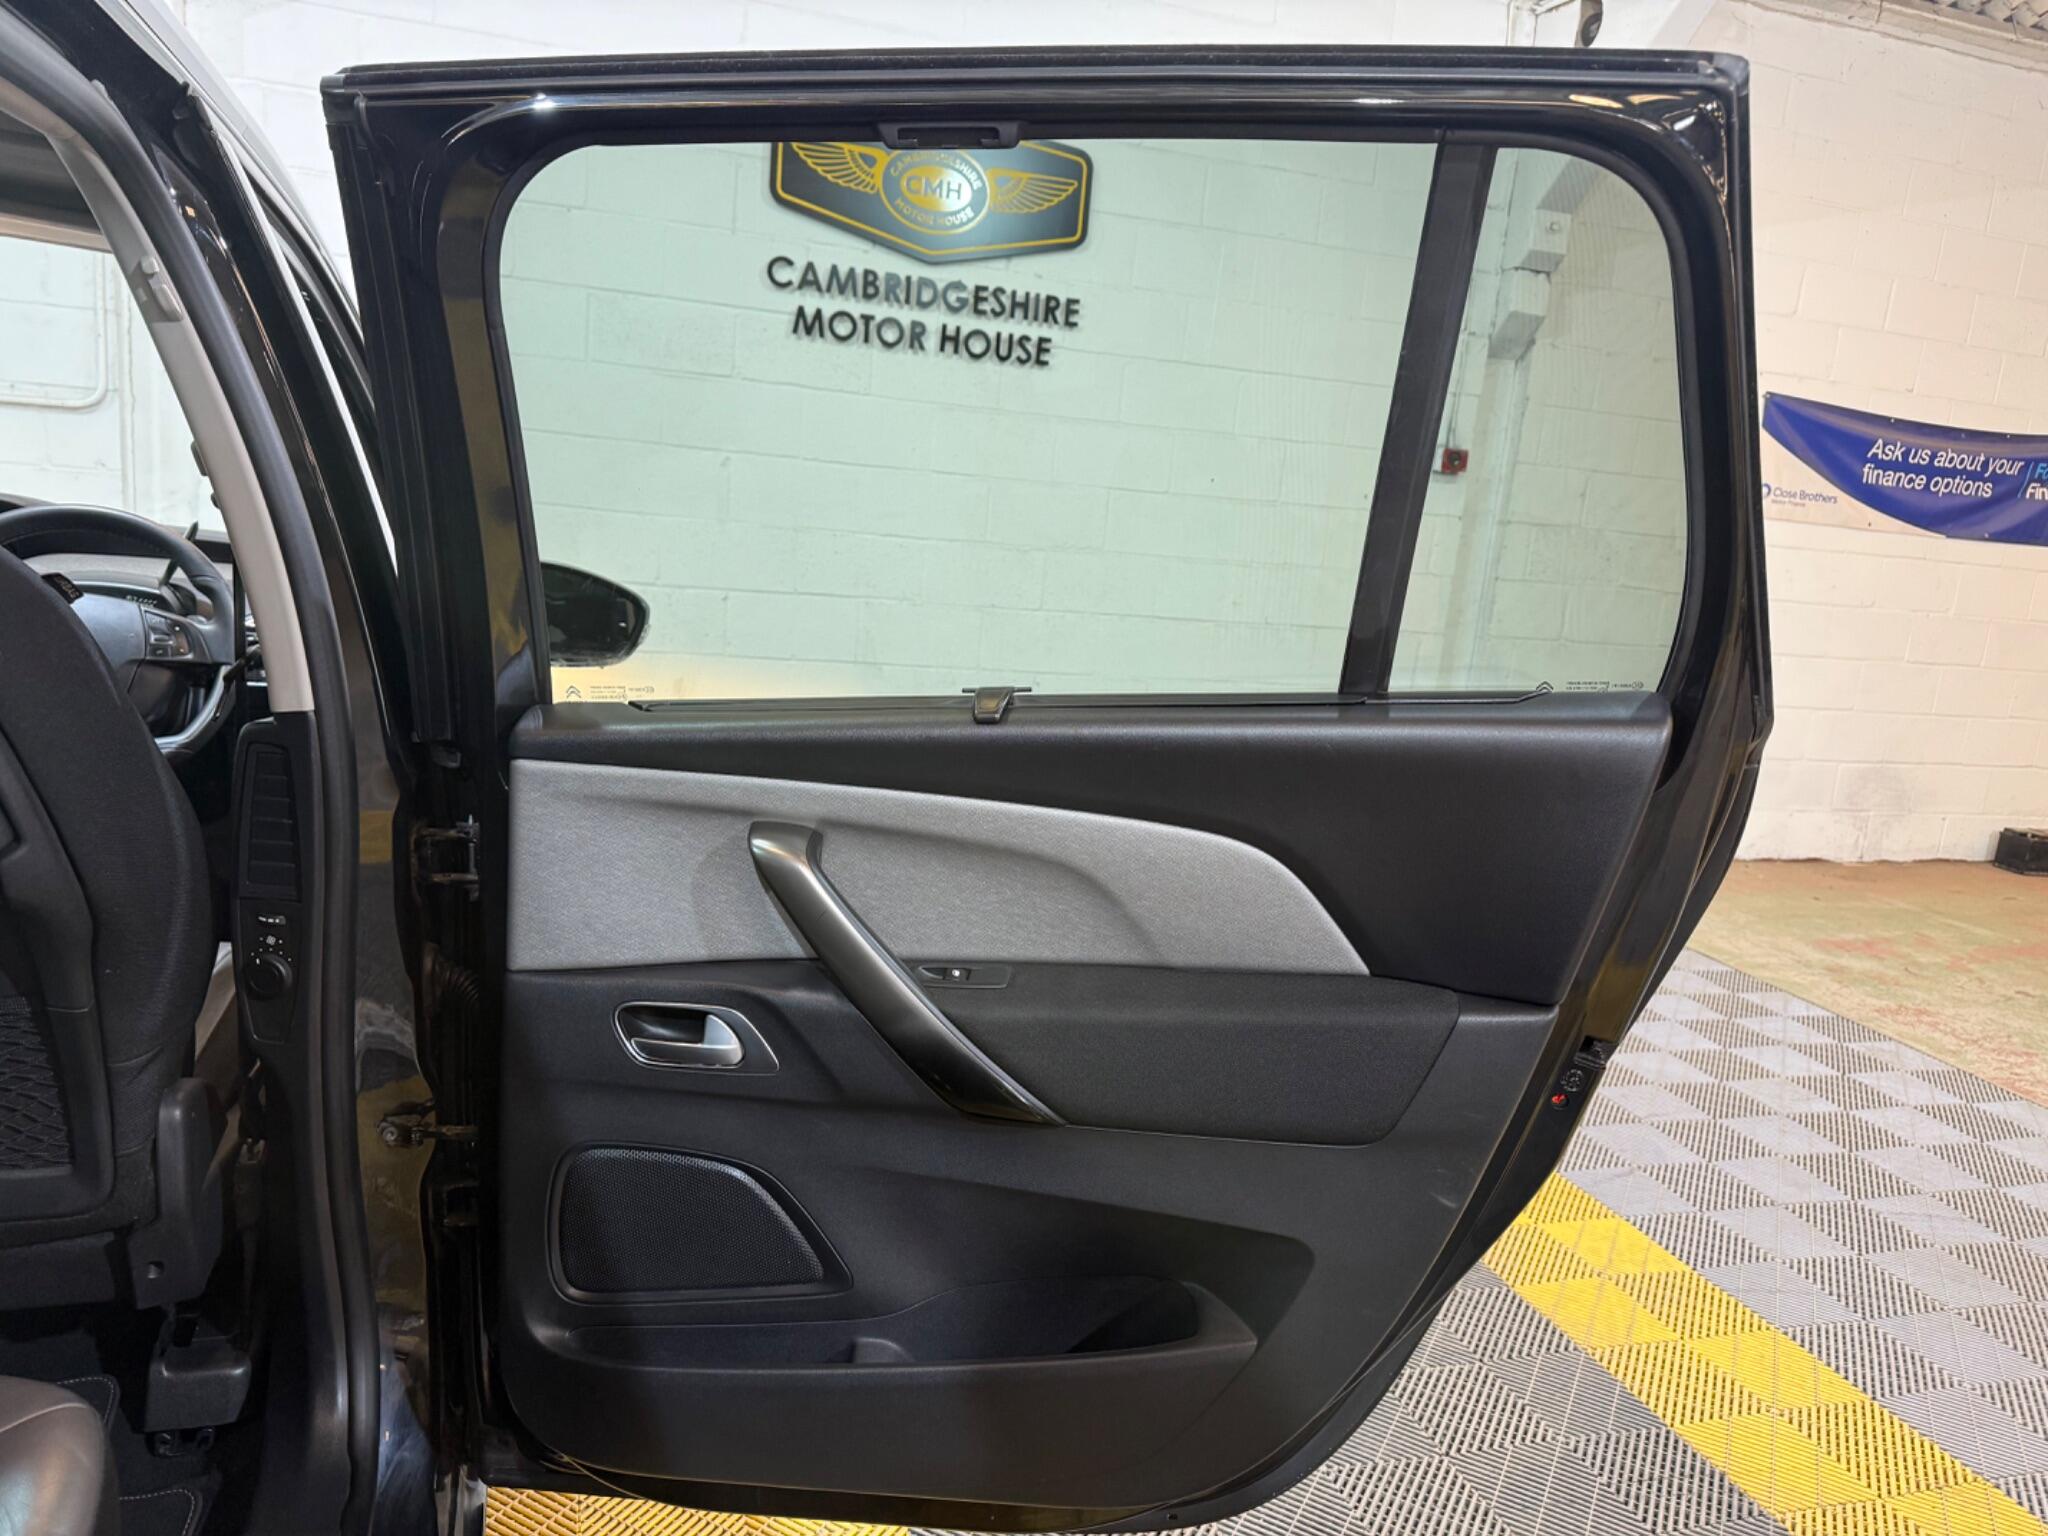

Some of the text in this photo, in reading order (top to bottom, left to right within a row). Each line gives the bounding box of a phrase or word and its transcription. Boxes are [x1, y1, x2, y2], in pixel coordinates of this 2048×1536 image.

[904, 174, 963, 200] CMH
[766, 256, 1081, 328] CAMBRIDGESHIRE
[792, 305, 1052, 367] MOTOR HOUSE
[1867, 438, 2025, 478] Ask us about your
[1773, 487, 1798, 499] Close
[1799, 489, 1838, 504] Brothers
[1862, 463, 1993, 498] finance options
